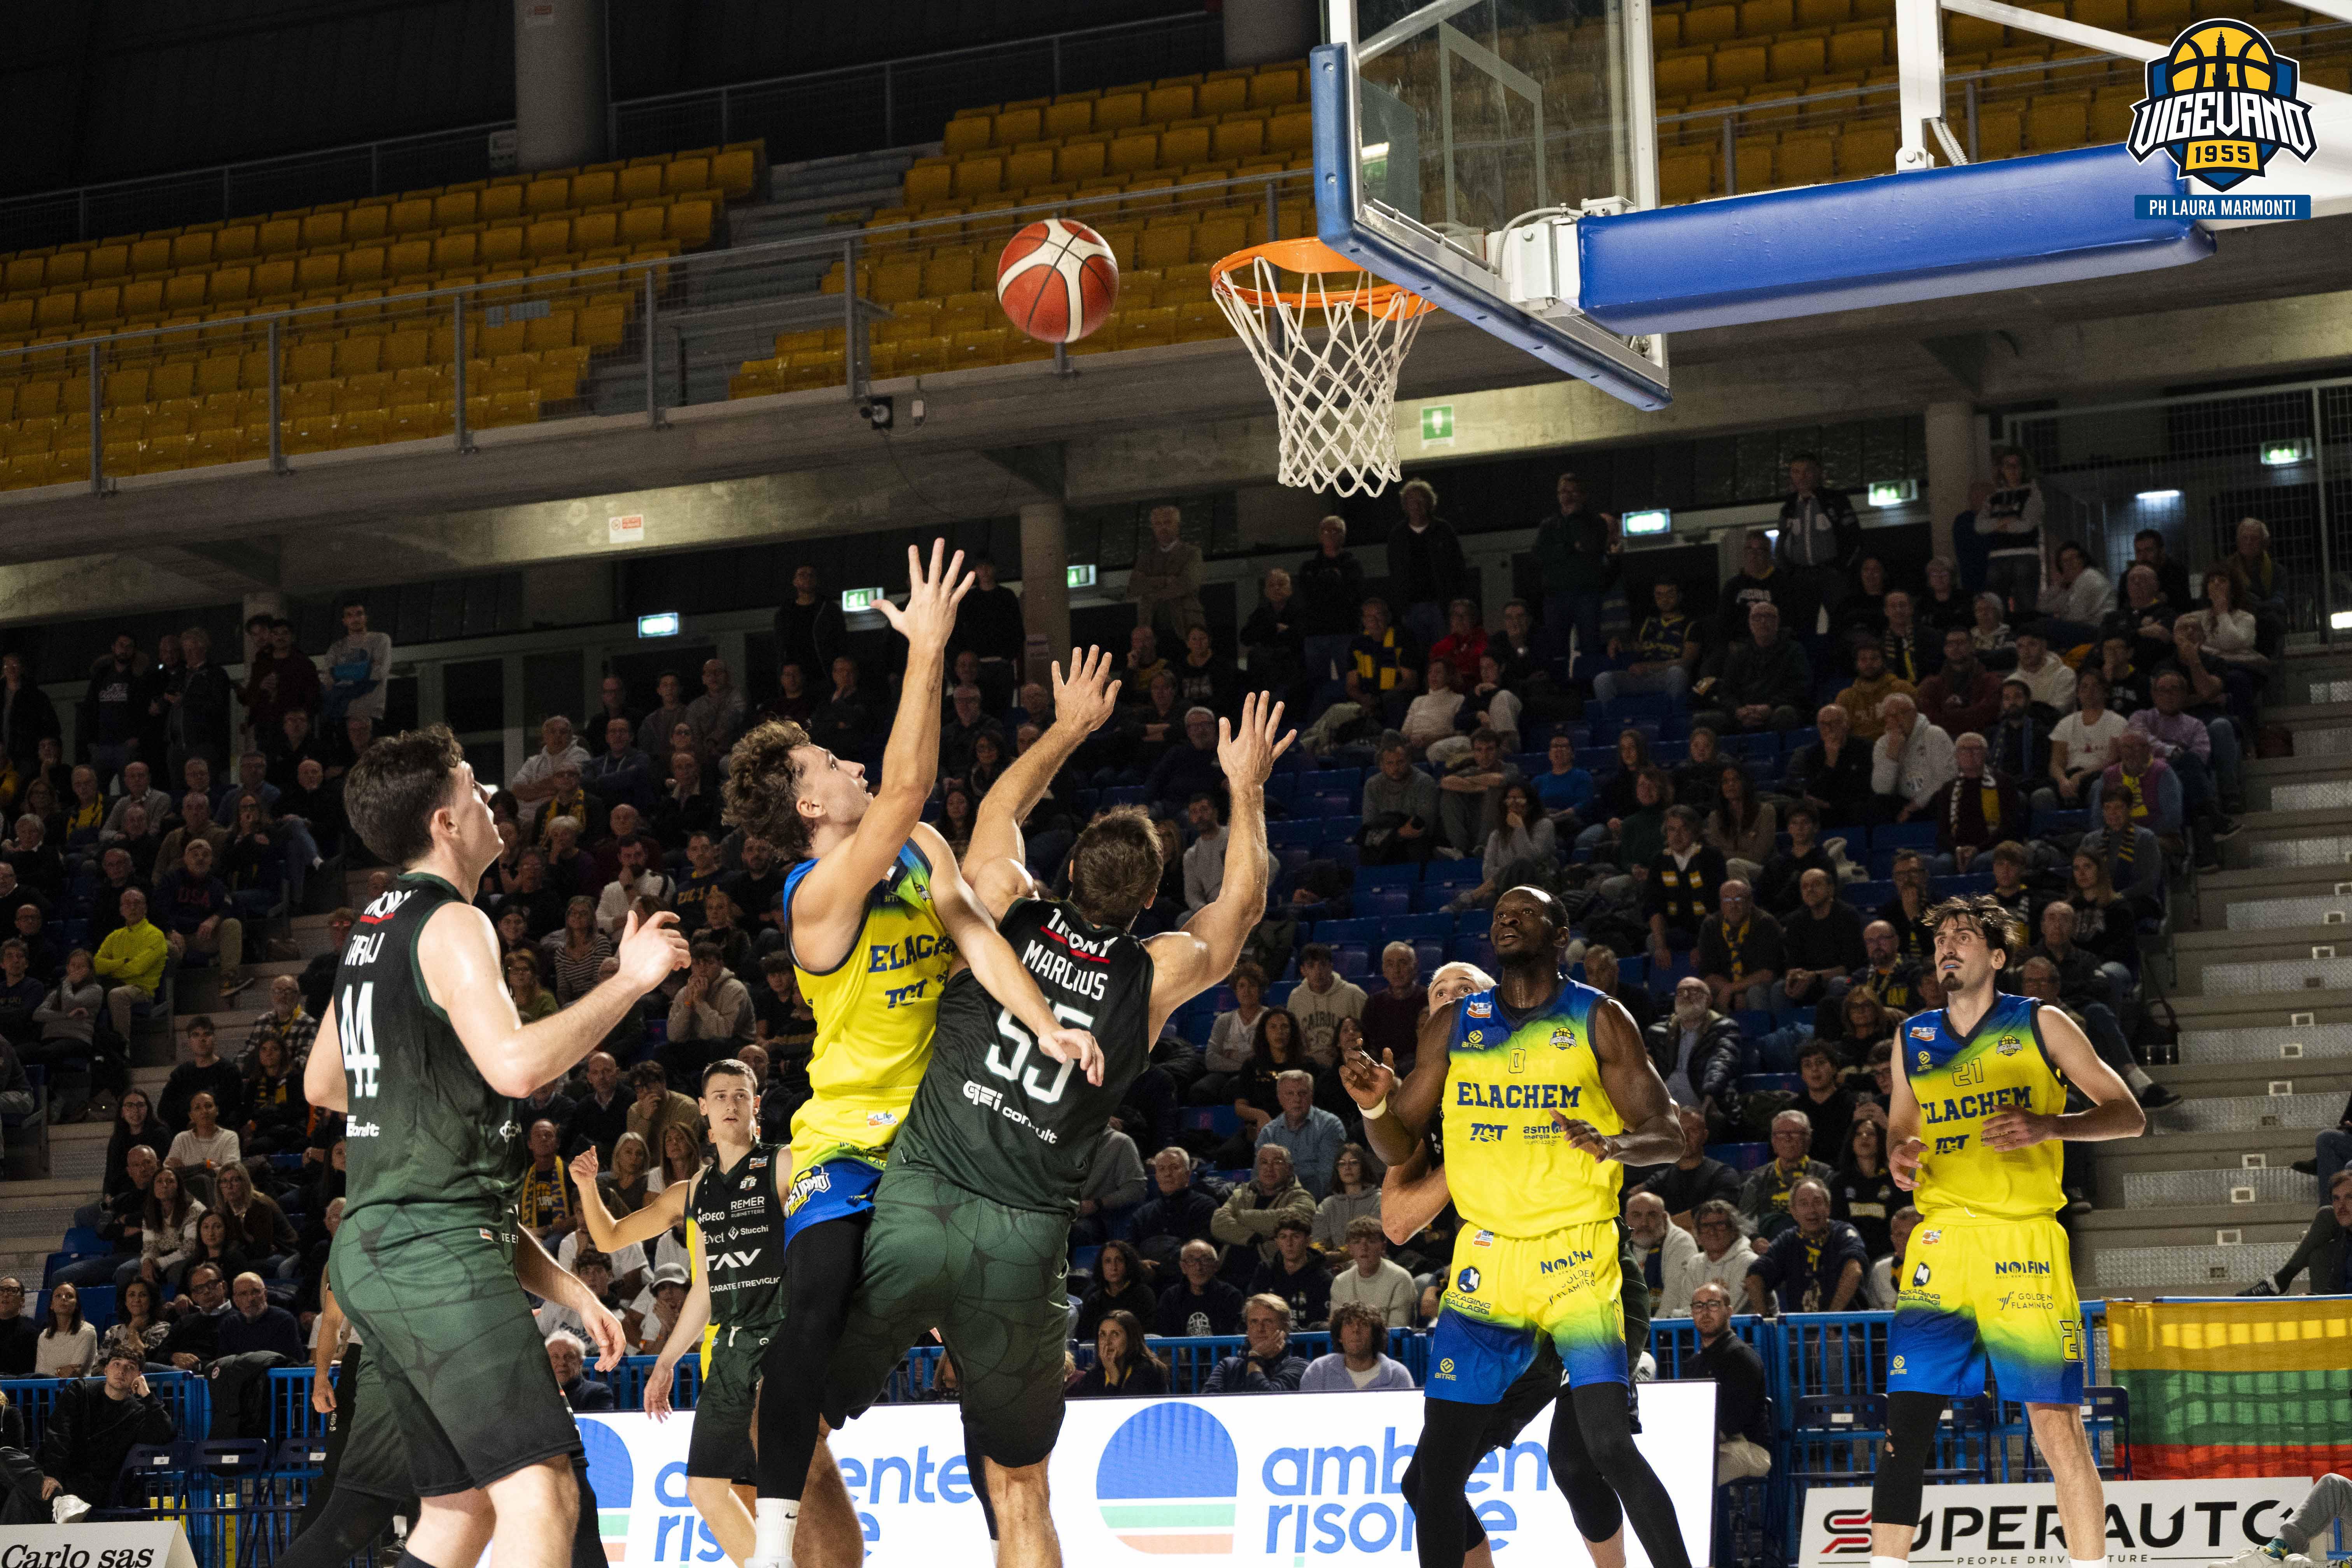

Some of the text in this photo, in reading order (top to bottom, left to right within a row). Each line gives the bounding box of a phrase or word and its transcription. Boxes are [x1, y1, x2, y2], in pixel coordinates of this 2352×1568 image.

[1022, 939, 1108, 1001] MARCIUS
[340, 981, 380, 1098] 44
[1461, 1041, 1486, 1050] BITRE
[984, 995, 1096, 1105] 55
[1951, 1057, 1984, 1087] 21
[1457, 1082, 1582, 1108] ELACHEM
[1002, 1106, 1057, 1144] conult
[1523, 1125, 1550, 1134] asm
[731, 1196, 765, 1210] REMER
[731, 1210, 765, 1218] RUBINETTERIE
[740, 1225, 769, 1236] Stucchi
[710, 1283, 737, 1293] CARATE
[1435, 1372, 1456, 1381] BITRE
[1, 1544, 154, 1568] Carlo sas
[1957, 1556, 2018, 1565] PEOPLE
[2028, 1556, 2071, 1564] DRIV
